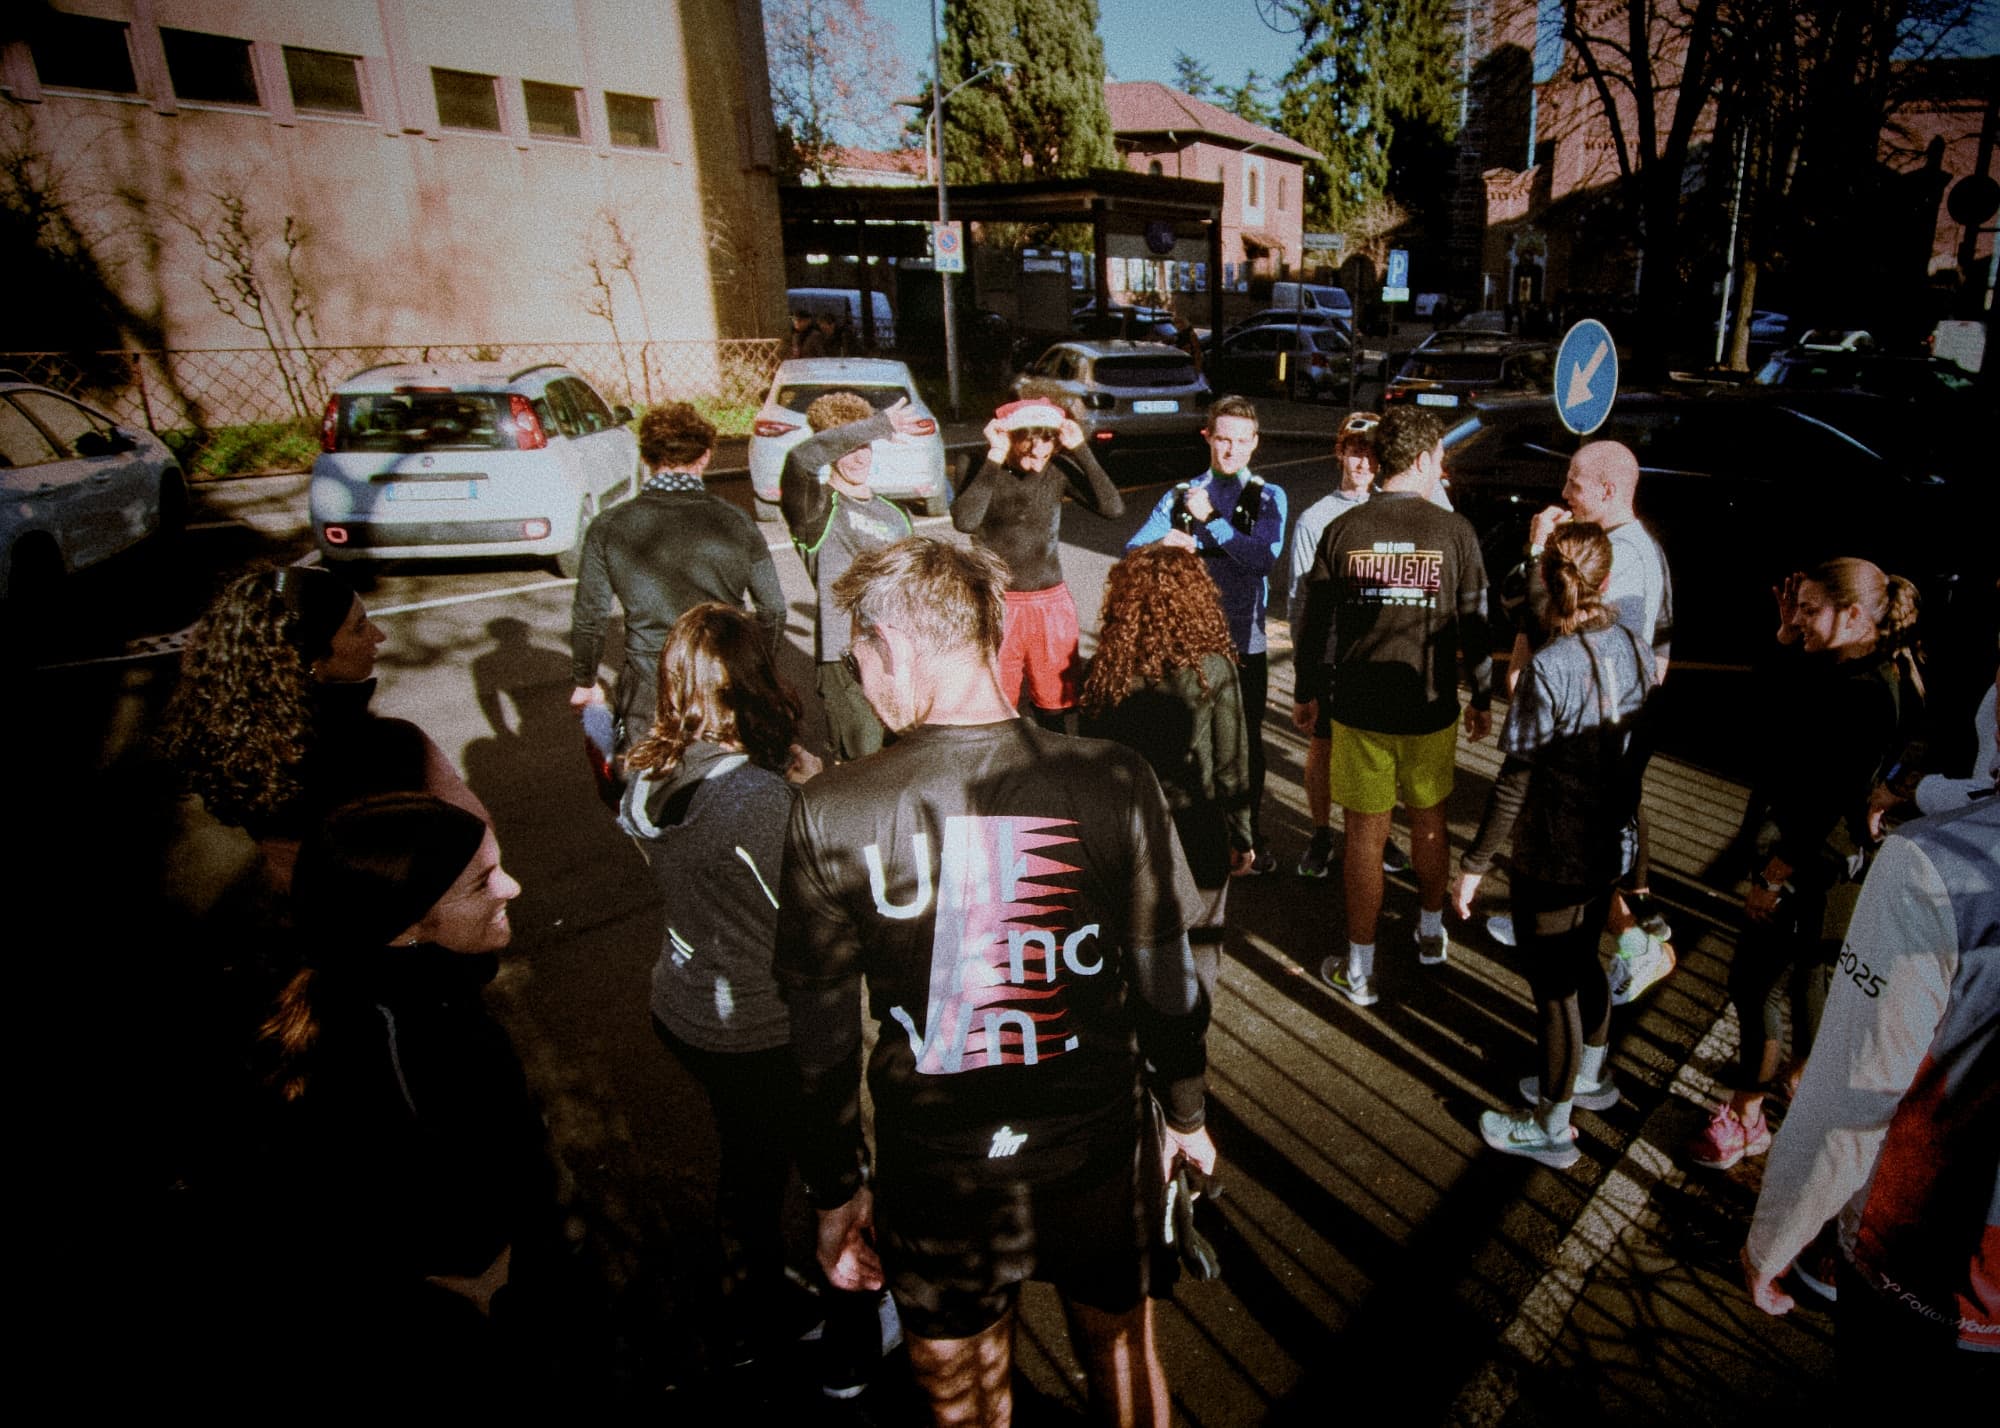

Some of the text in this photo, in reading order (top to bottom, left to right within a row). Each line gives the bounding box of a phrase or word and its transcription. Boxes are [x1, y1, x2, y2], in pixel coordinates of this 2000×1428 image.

[1391, 254, 1405, 284] P
[1346, 550, 1442, 590] ATHLETE
[1840, 943, 1887, 997] 2025
